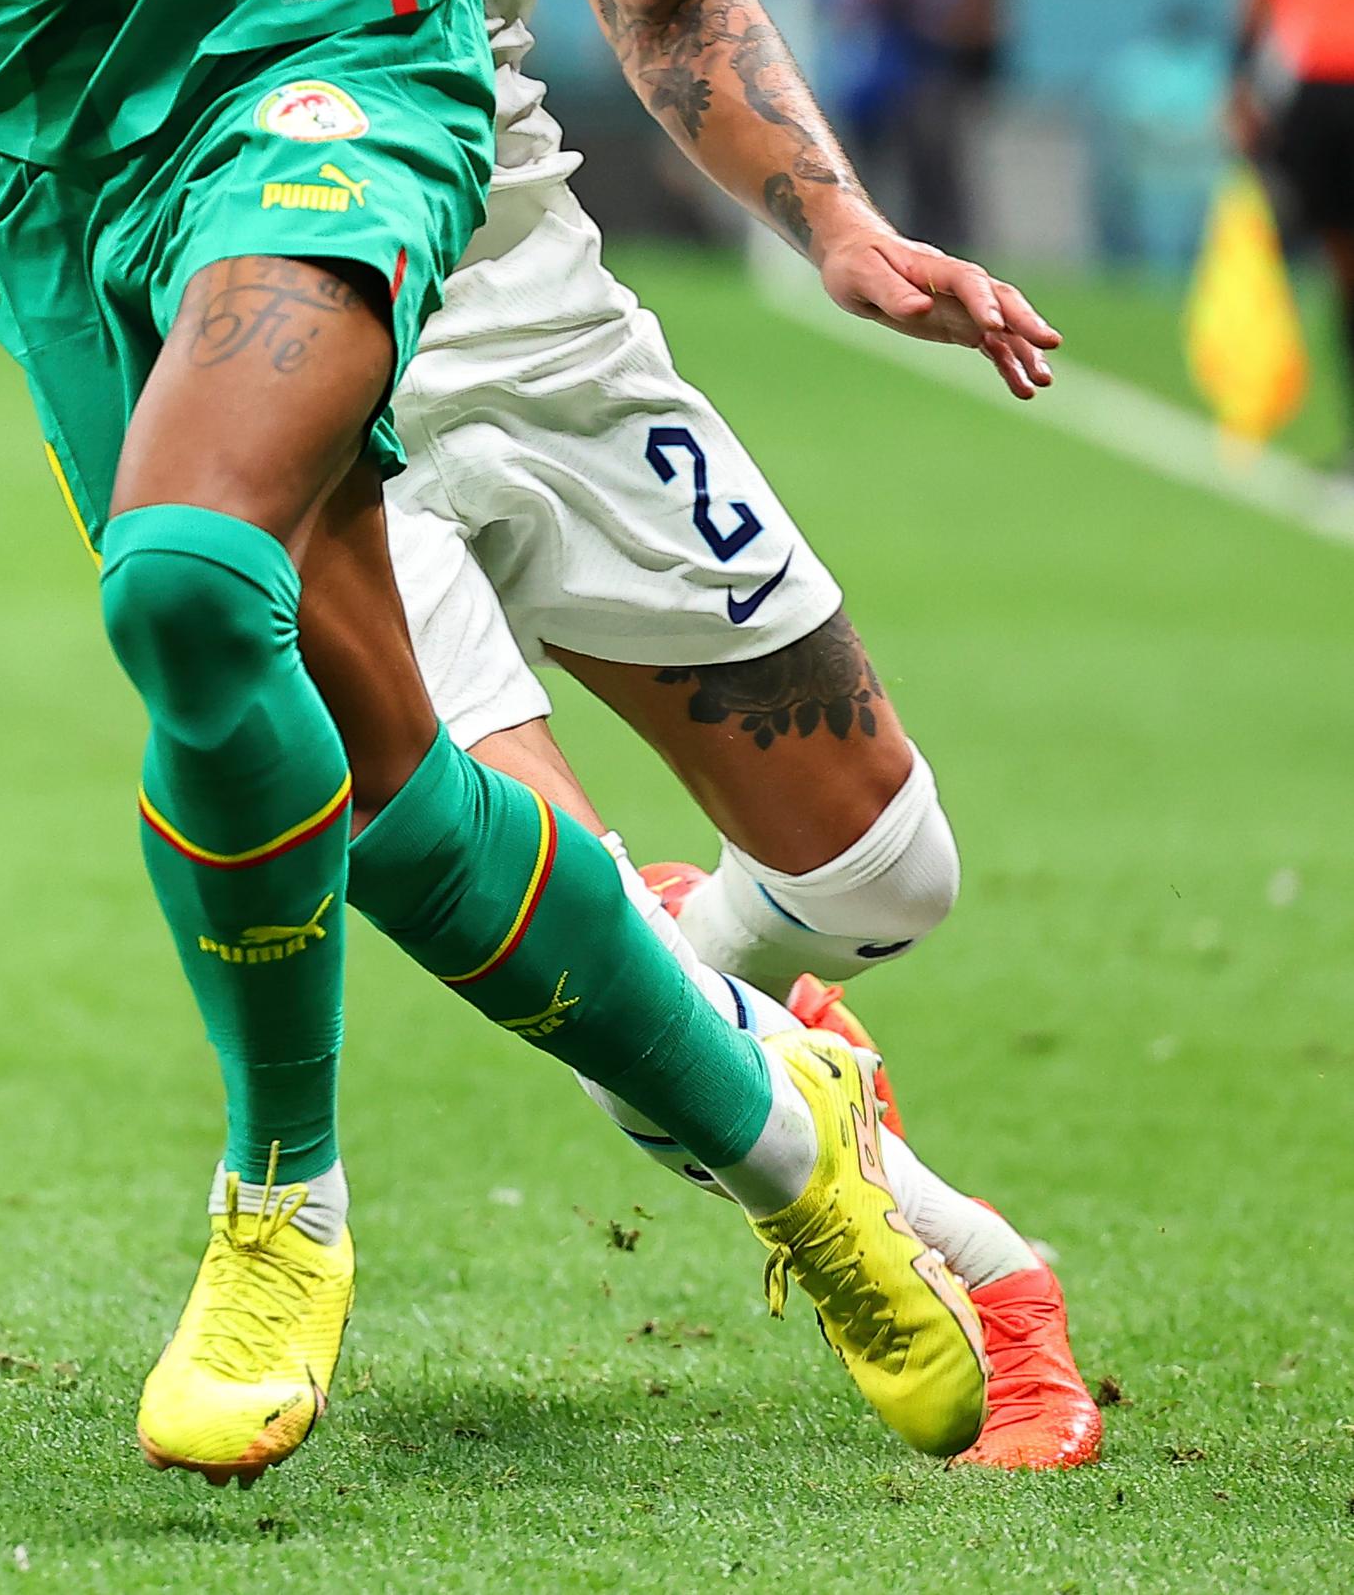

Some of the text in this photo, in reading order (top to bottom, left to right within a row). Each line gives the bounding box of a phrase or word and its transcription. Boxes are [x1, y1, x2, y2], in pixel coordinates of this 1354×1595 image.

[260, 182, 351, 213] PUMA
[645, 427, 764, 562] 2
[198, 934, 307, 965] PUMA
